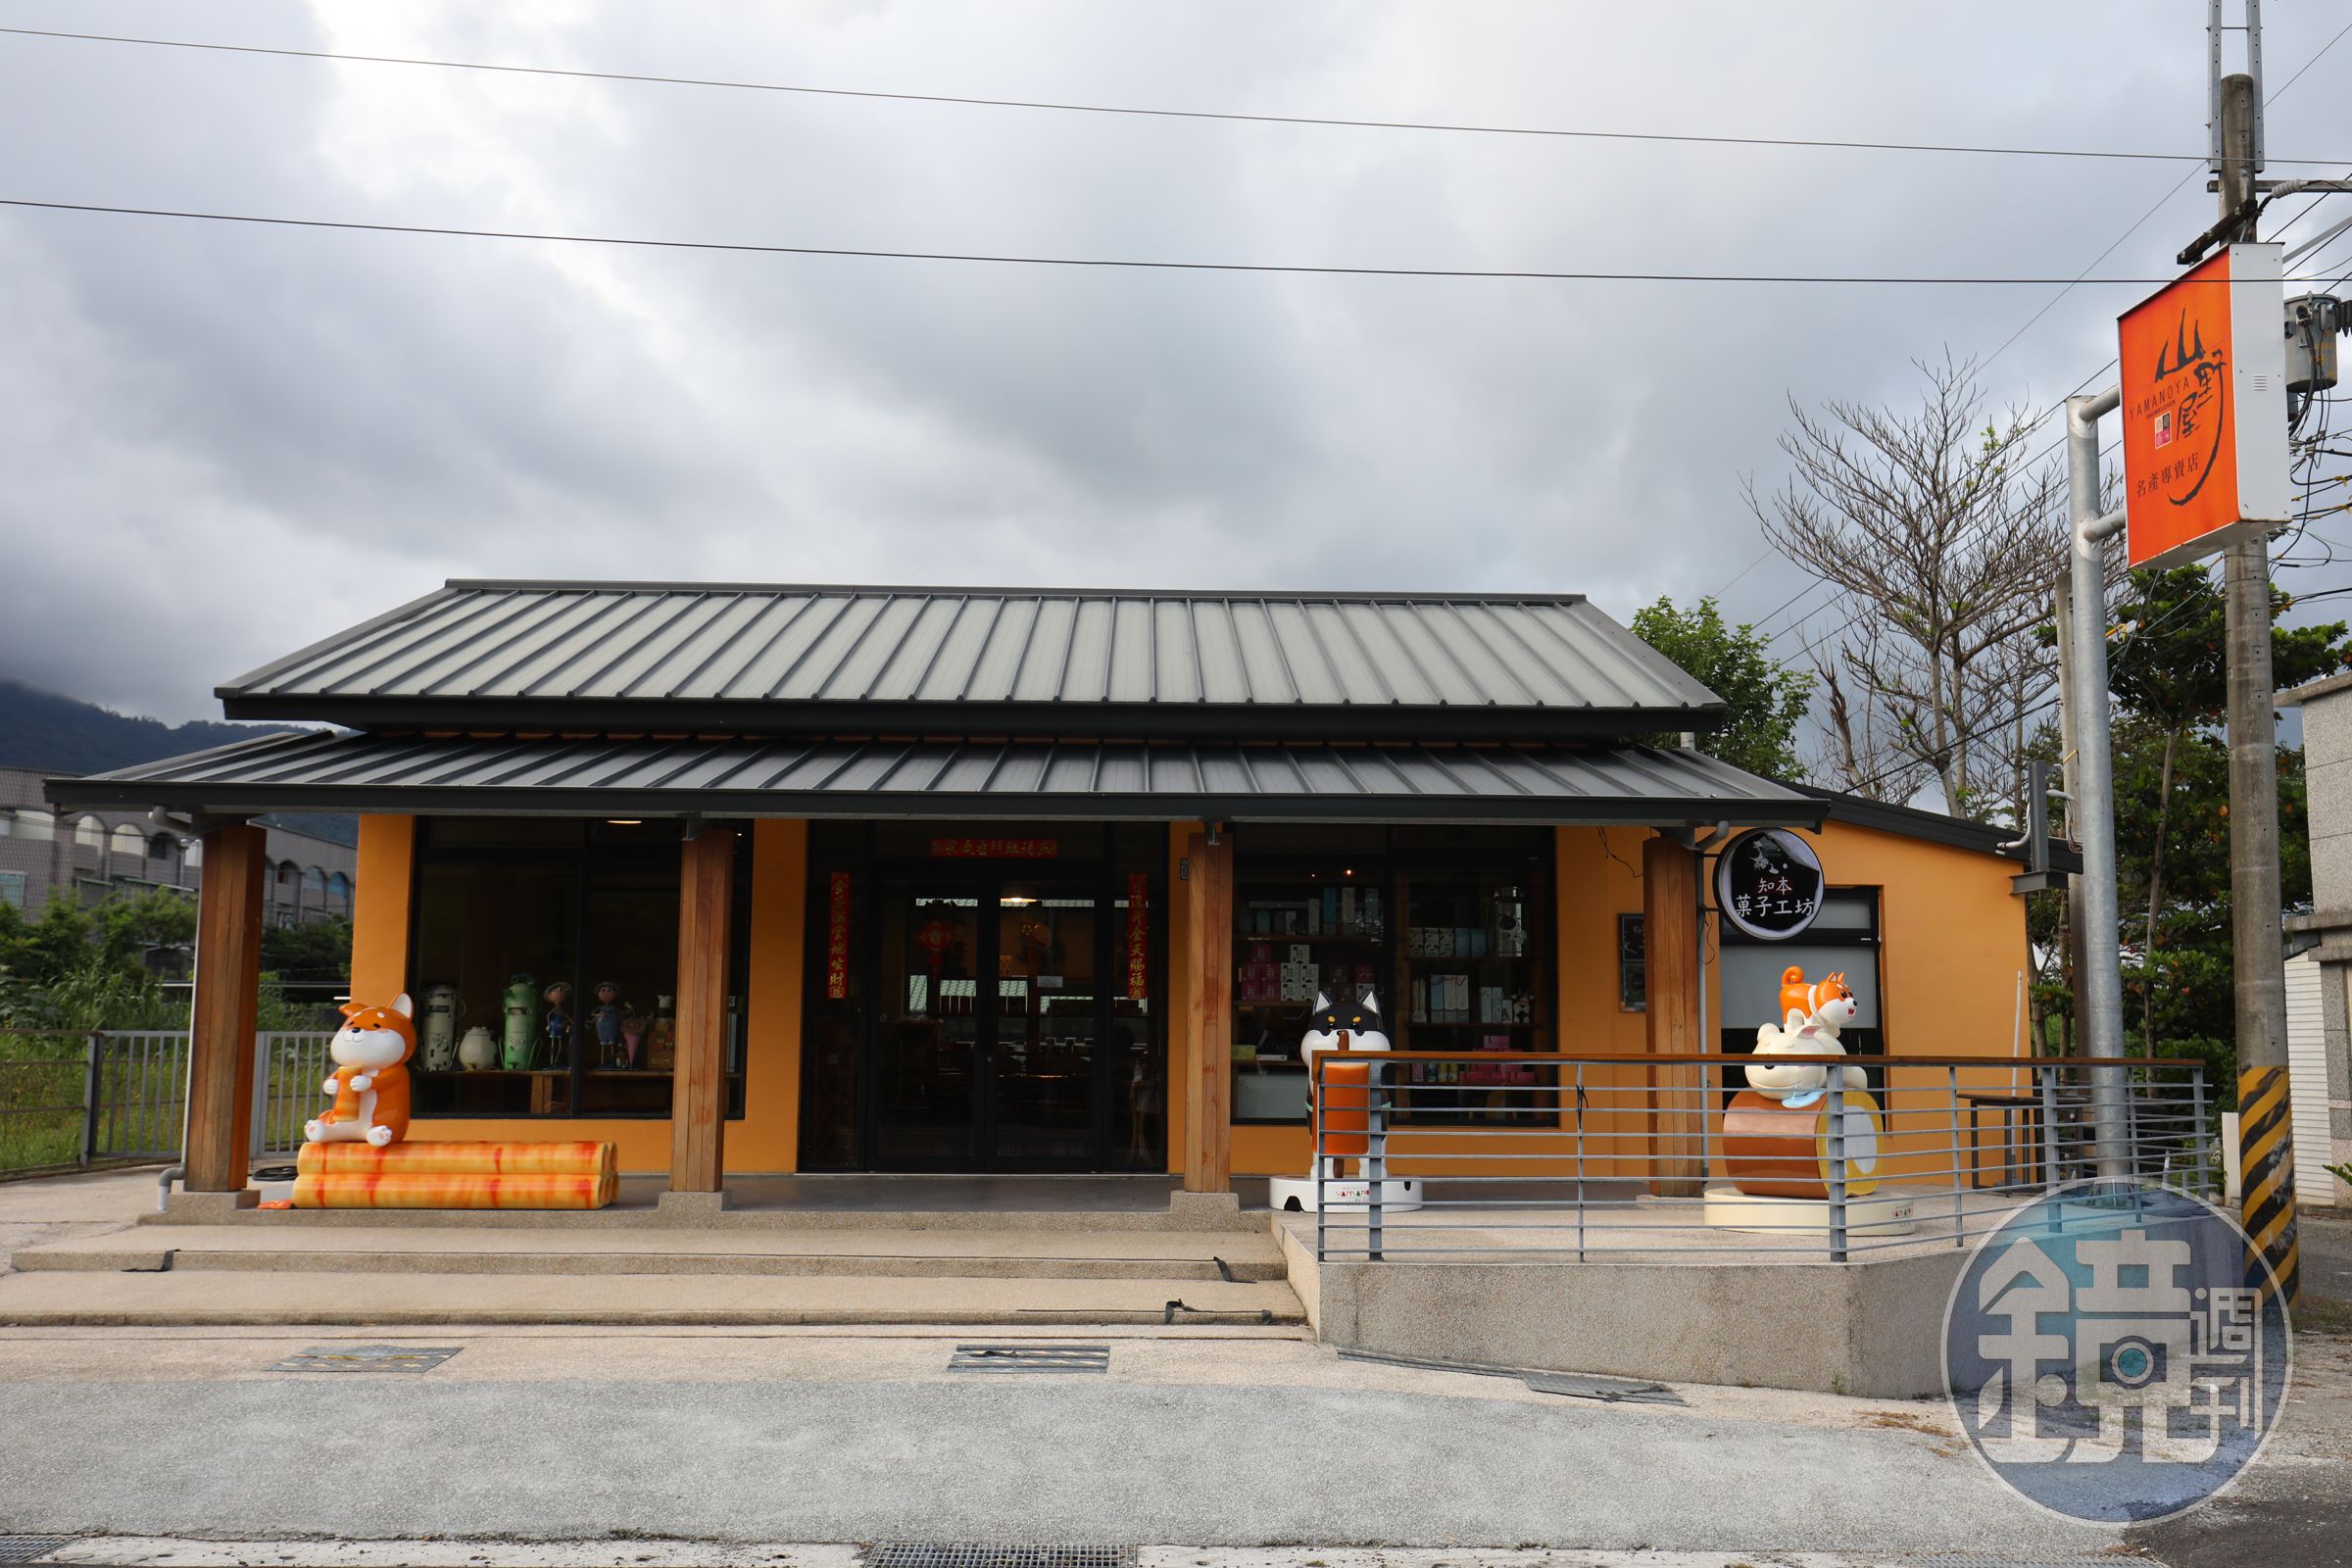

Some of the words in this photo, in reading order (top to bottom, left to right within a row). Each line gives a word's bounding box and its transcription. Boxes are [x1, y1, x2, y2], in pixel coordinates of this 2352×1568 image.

[2129, 376, 2189, 420] YAMANOYA
[2136, 452, 2199, 498] 名產專賣店
[1758, 876, 1792, 896] 知本
[1736, 893, 1814, 917] 菓子工坊
